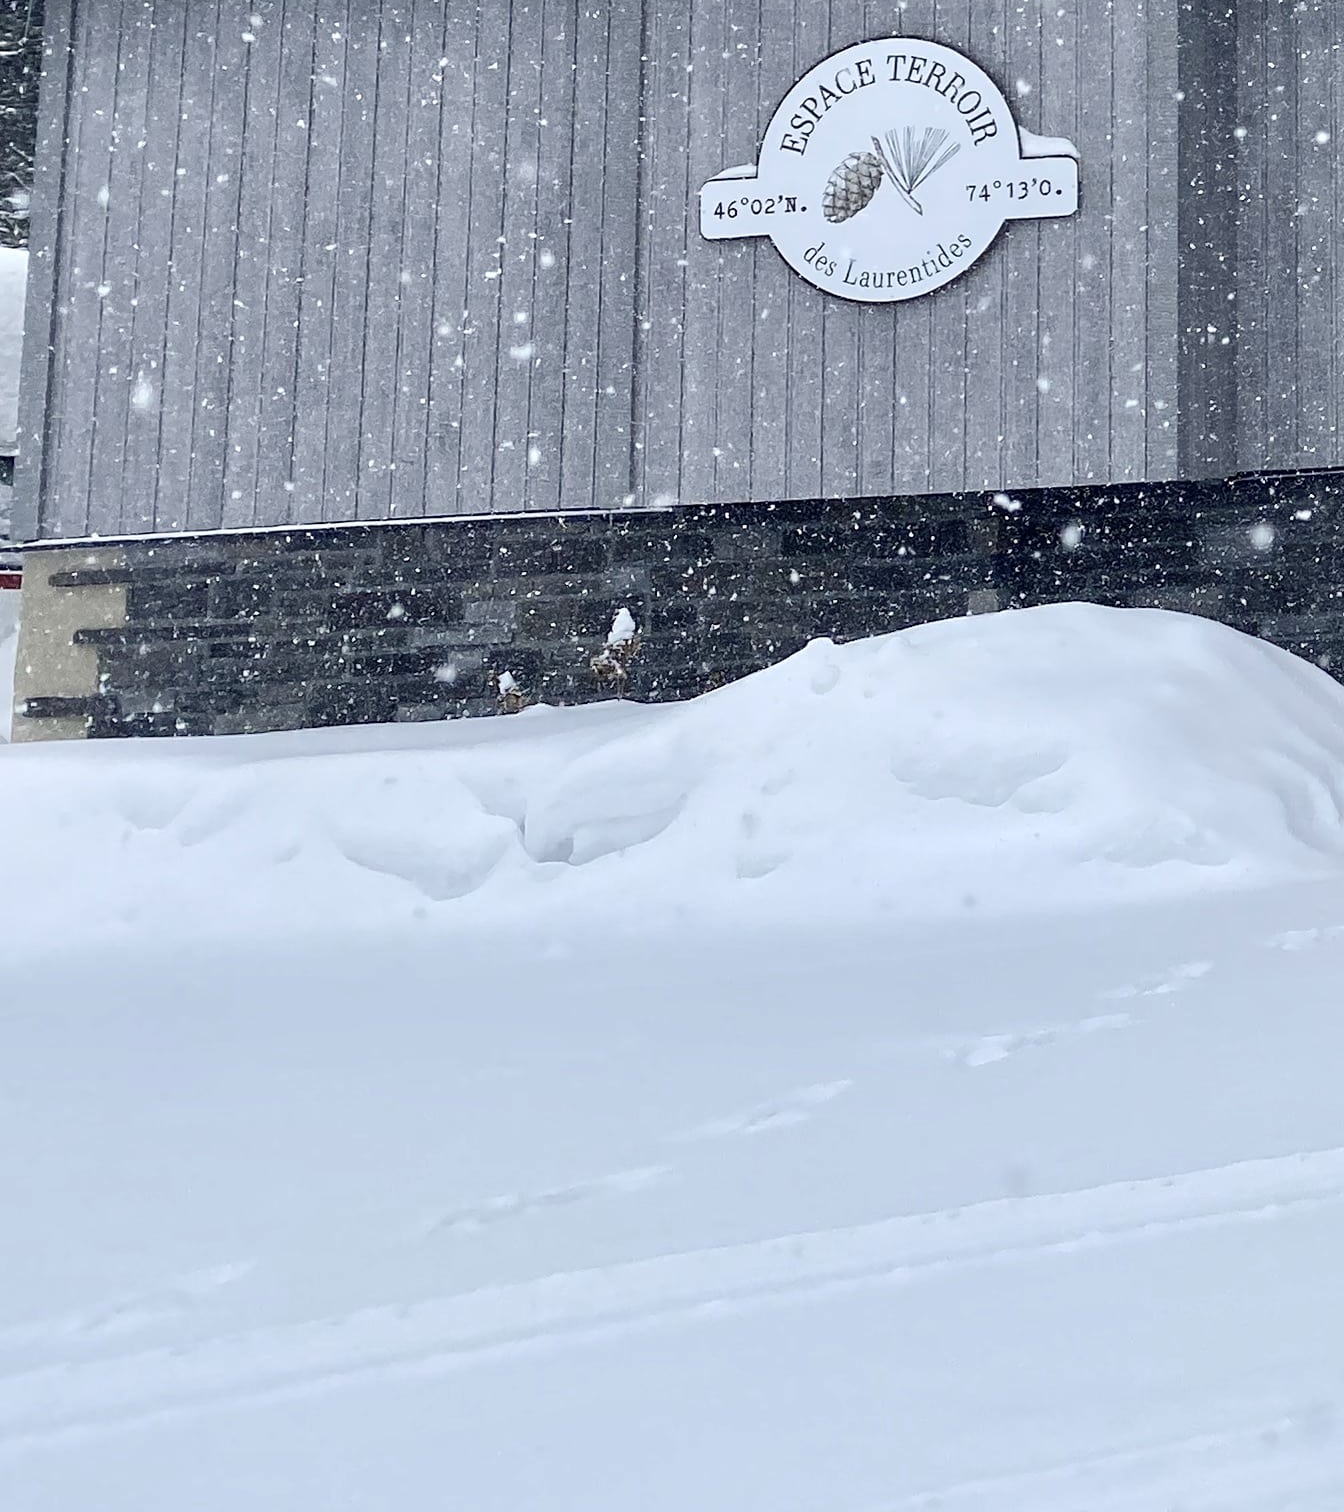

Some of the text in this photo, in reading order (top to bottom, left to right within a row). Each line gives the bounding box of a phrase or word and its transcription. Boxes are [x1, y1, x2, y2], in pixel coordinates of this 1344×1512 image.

[779, 55, 998, 156] ESPACE TERROIR
[803, 231, 972, 288] des Laurentides
